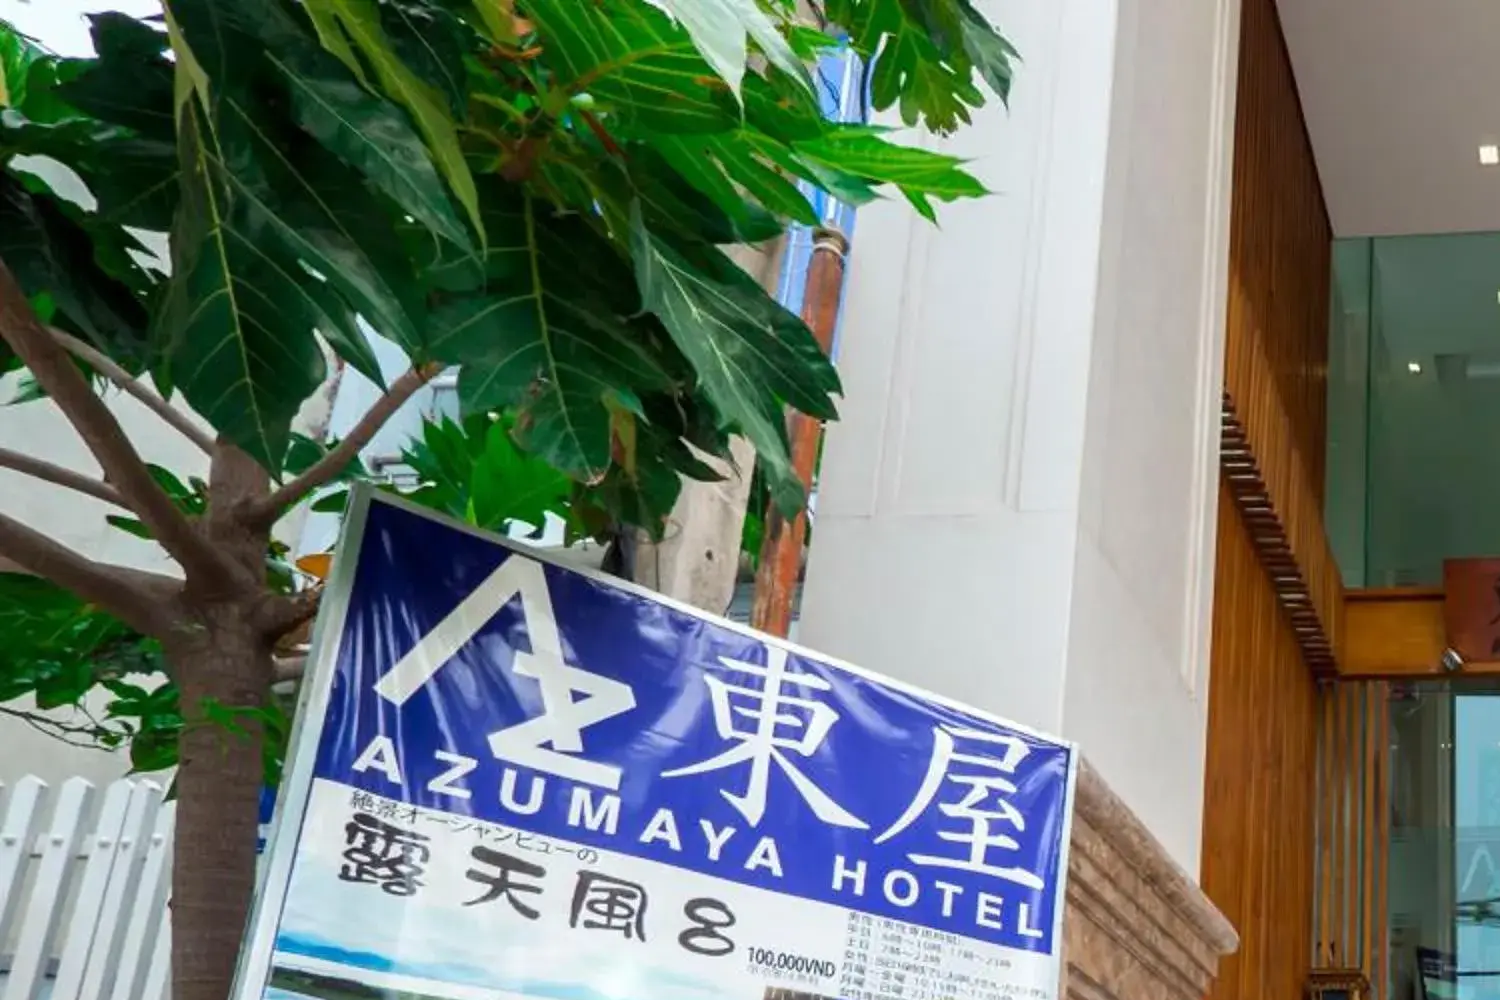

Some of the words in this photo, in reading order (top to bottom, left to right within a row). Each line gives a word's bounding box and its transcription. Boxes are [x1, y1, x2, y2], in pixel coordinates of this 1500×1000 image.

[352, 735, 783, 879] AZUMAYA
[831, 853, 1045, 939] HOTEL
[661, 642, 1044, 891] 東屋
[338, 812, 736, 957] 露天風呂
[748, 946, 836, 978] 100,000VND
